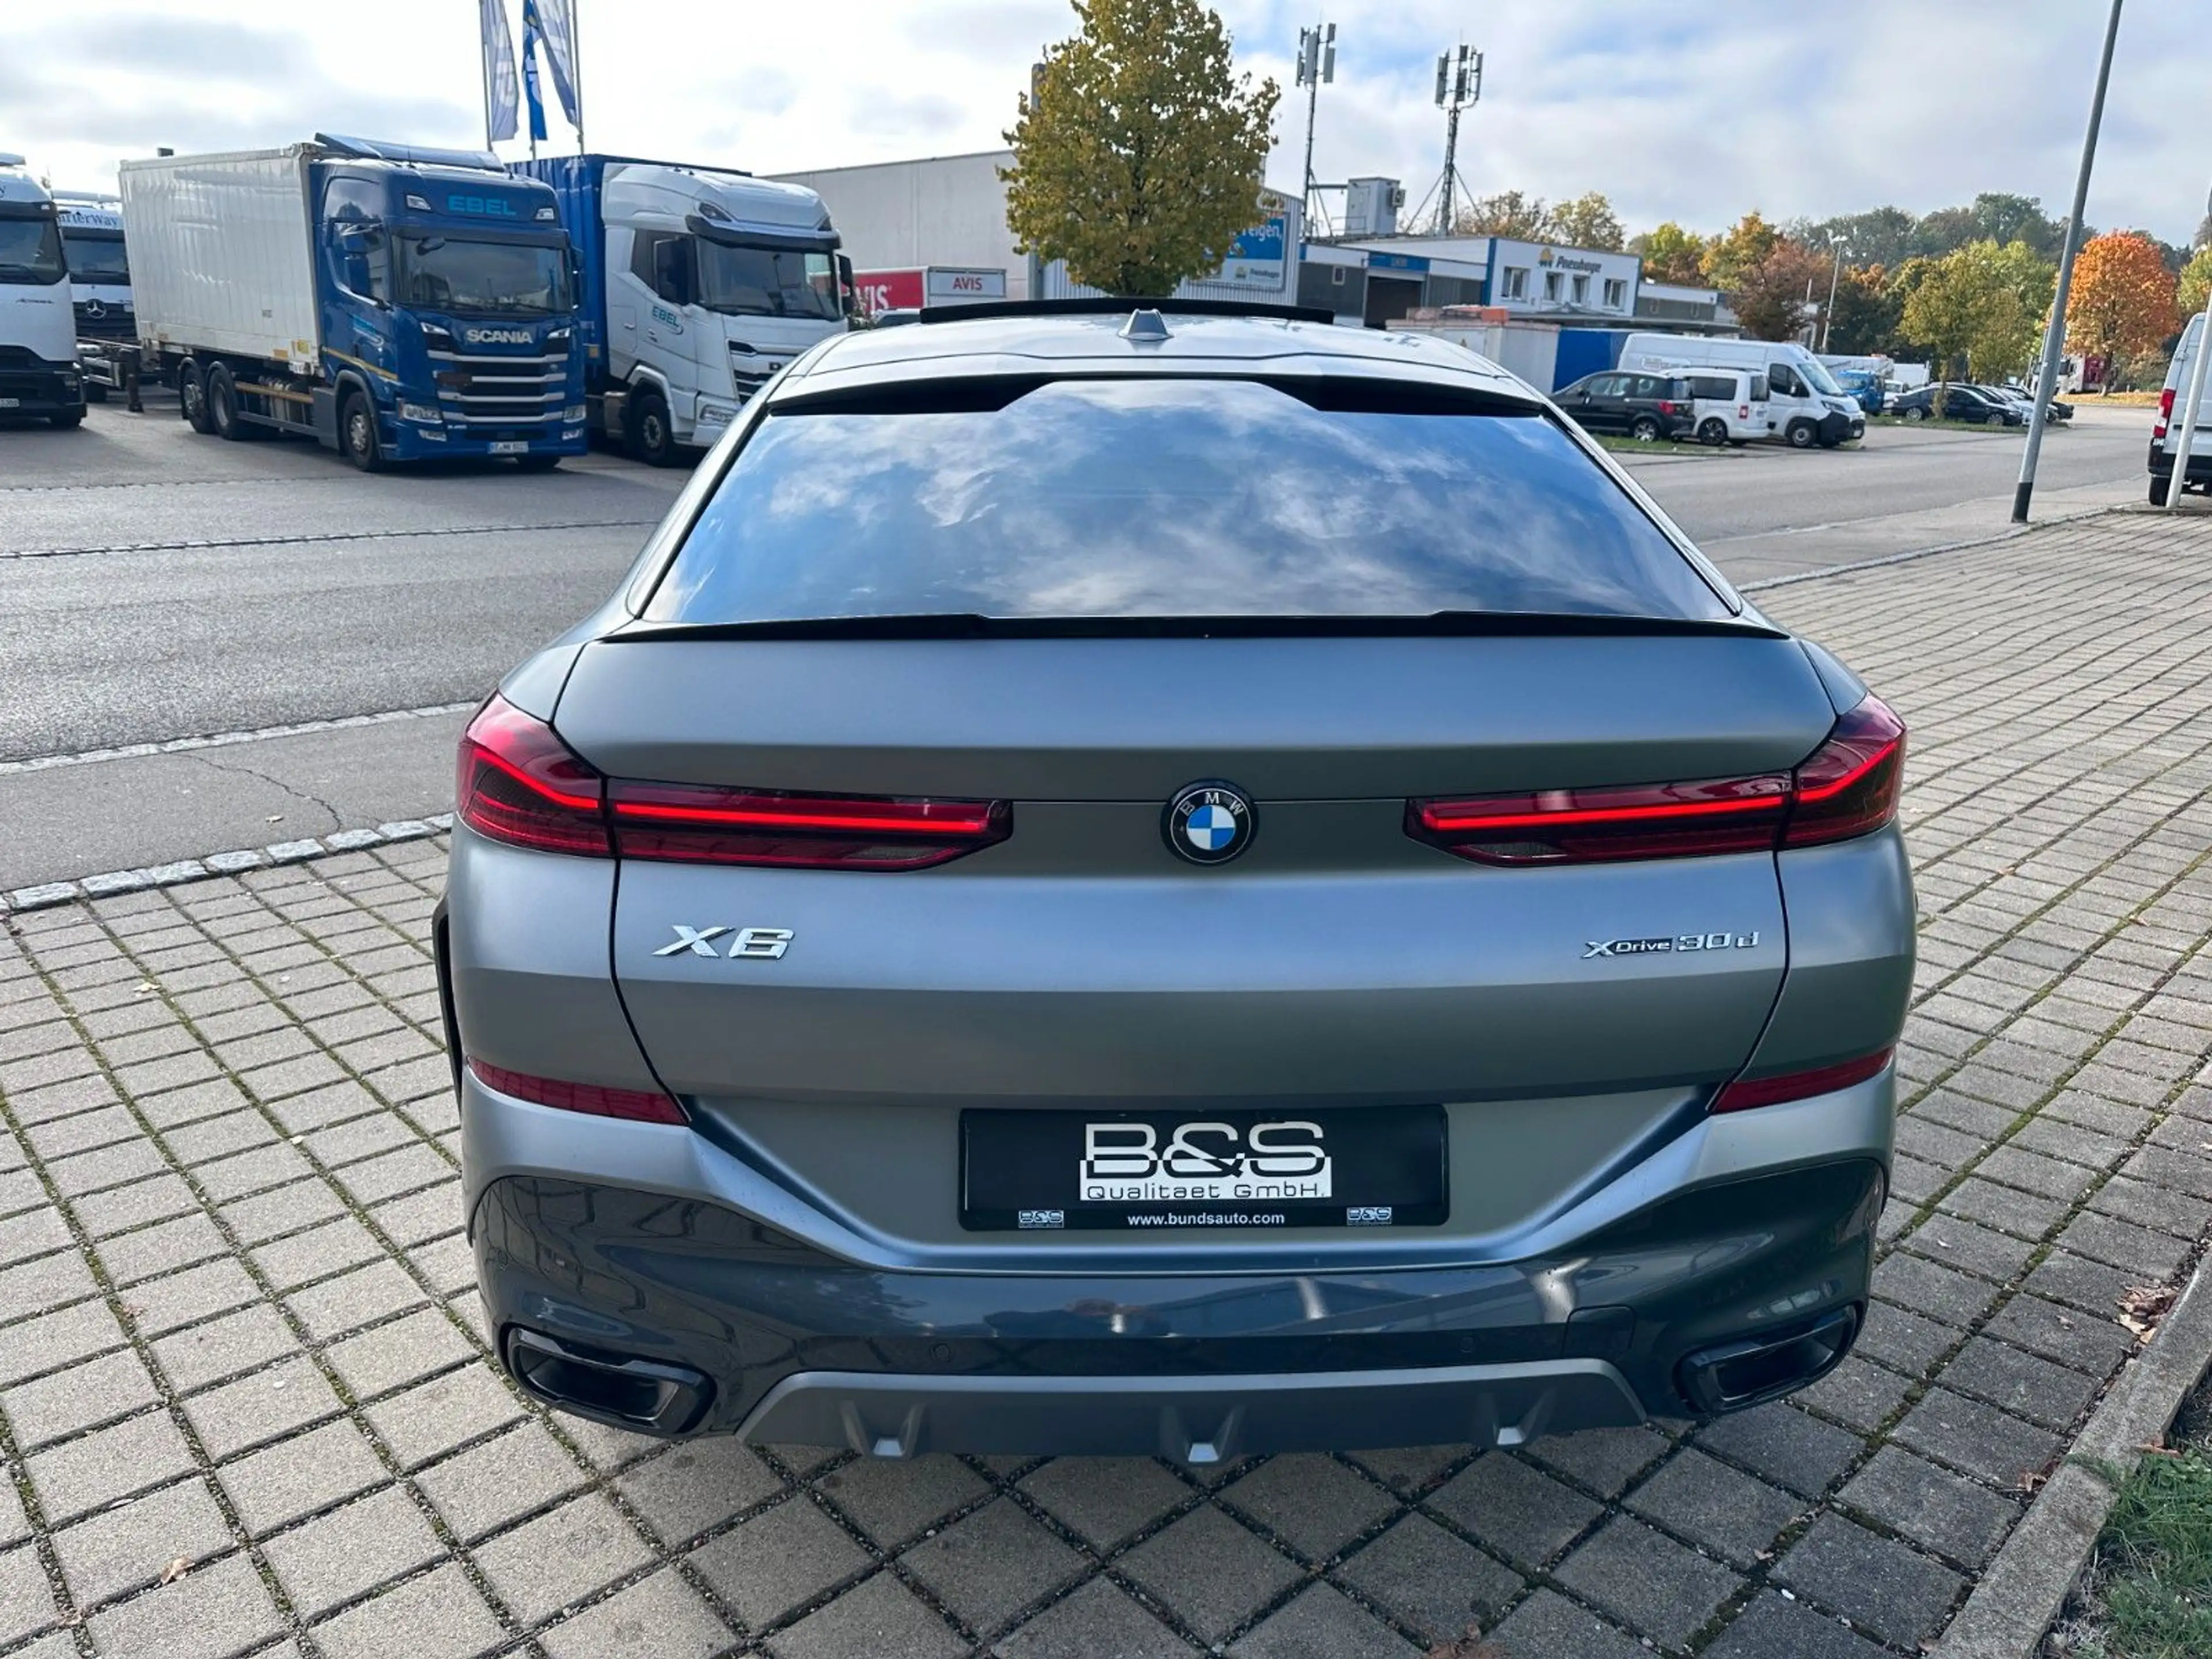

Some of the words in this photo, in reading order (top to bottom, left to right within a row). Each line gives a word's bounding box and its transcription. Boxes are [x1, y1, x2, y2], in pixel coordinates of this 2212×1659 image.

[448, 195, 516, 215] EBEL
[953, 277, 982, 291] AVIS
[652, 306, 679, 327] EBEL
[466, 329, 533, 344] SCANIA
[1179, 791, 1244, 816] BMW
[652, 925, 795, 959] X6
[1086, 1121, 1325, 1179] B&S
[1087, 1183, 1219, 1199] Qualitaet
[1020, 1210, 1063, 1223] B&S
[1127, 1212, 1285, 1226] www.bundsauto.com
[1347, 1207, 1391, 1220] B&S
